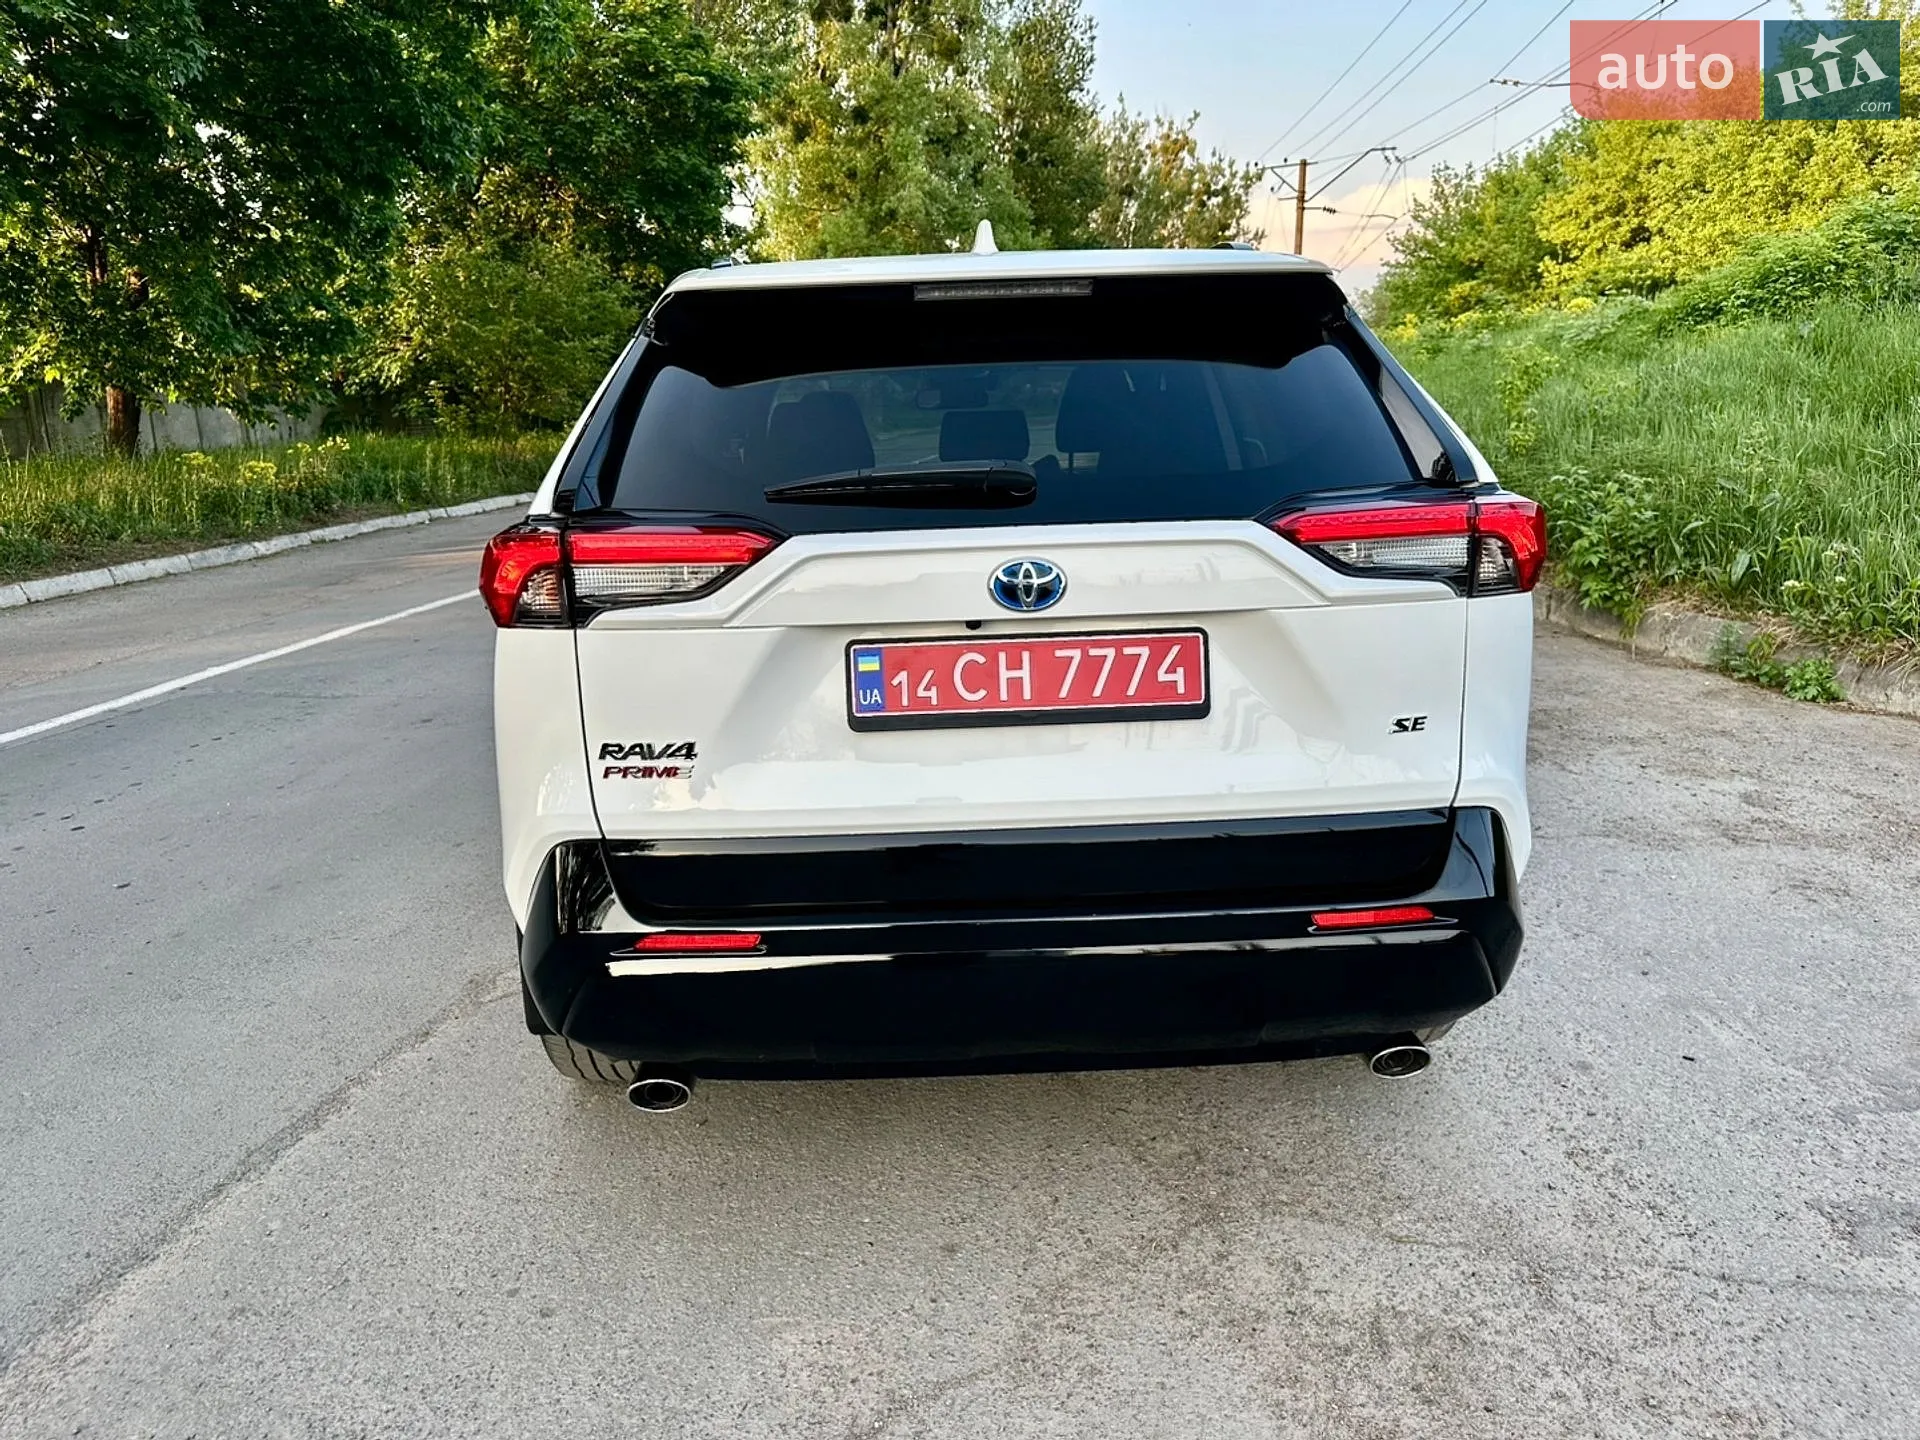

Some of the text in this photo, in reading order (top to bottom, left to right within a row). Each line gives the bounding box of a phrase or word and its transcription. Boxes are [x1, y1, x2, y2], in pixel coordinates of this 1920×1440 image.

[890, 644, 1186, 707] 14 CH 7774
[859, 688, 882, 705] UA
[1389, 715, 1428, 734] SE
[598, 741, 698, 761] RAV4
[602, 765, 695, 780] PRIME
